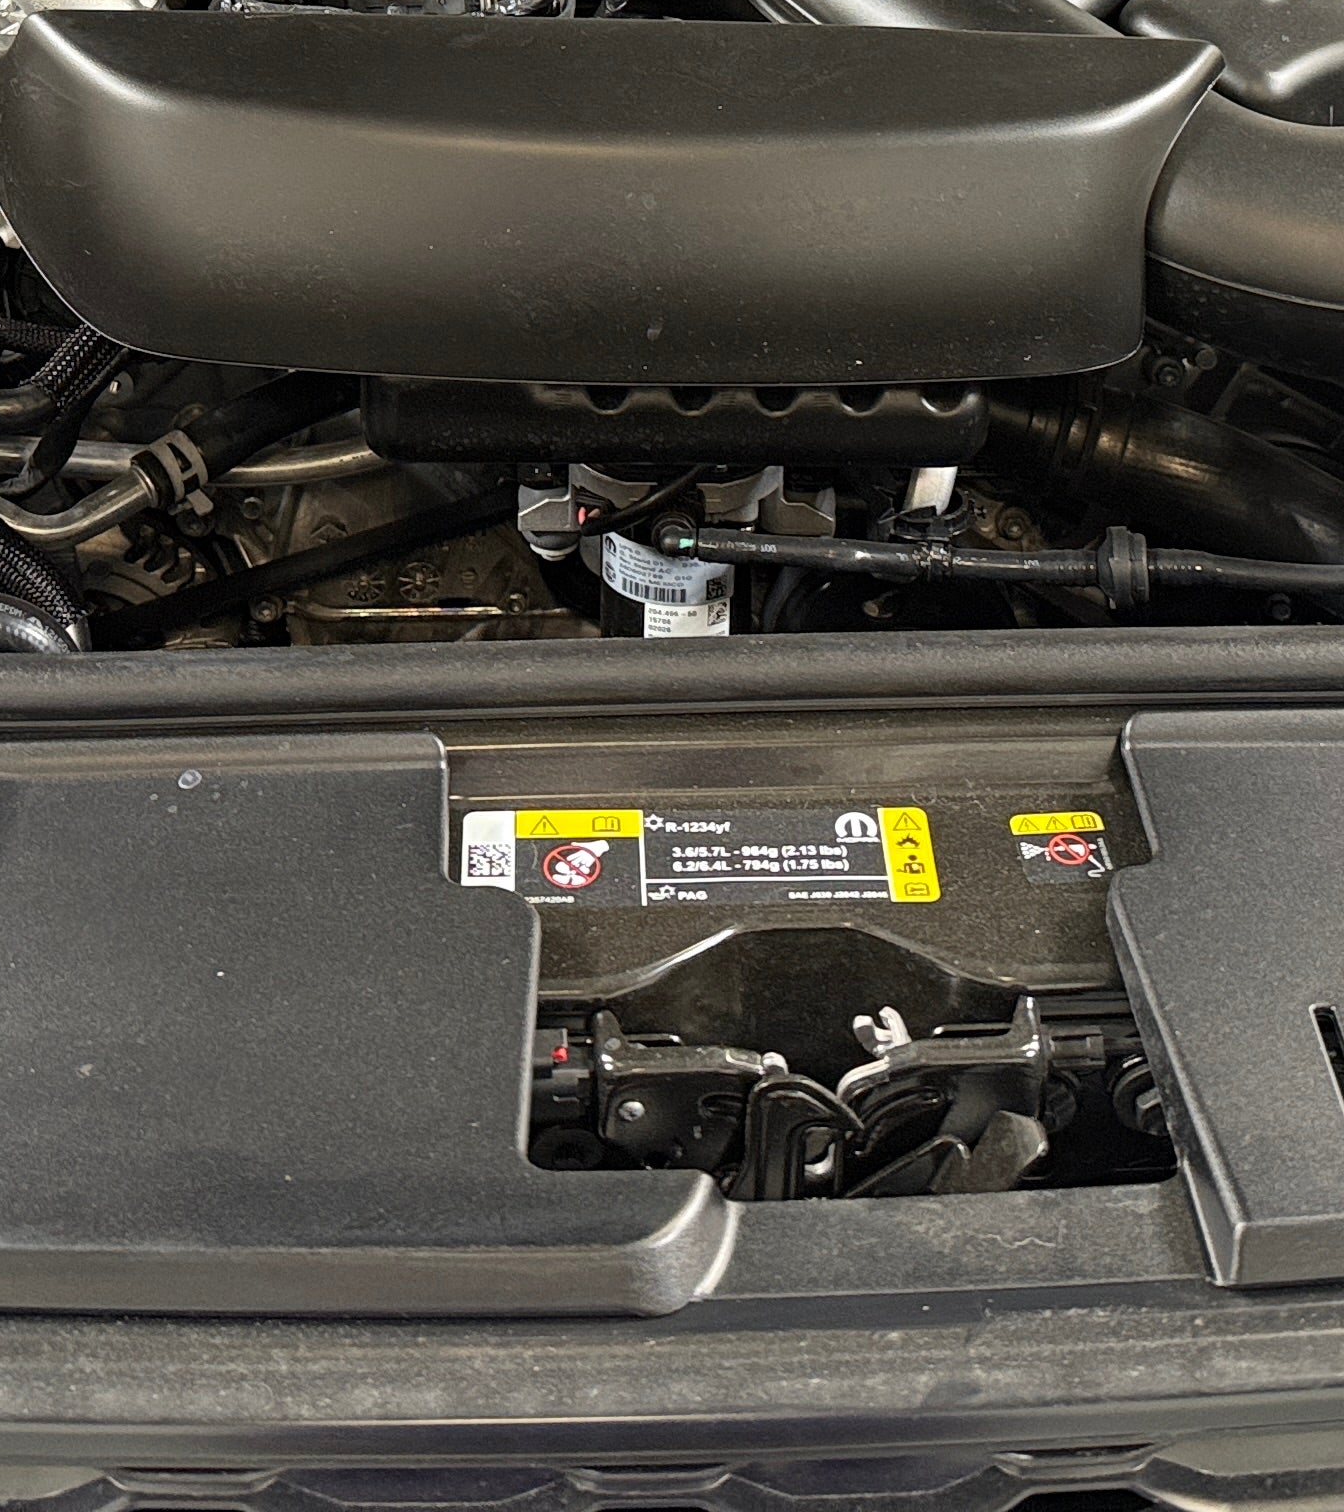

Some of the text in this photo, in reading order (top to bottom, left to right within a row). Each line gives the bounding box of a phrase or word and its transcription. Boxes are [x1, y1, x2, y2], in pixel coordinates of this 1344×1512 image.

[665, 821, 731, 835] R-1234yf
[672, 846, 732, 858] 3.6/5.7L
[781, 845, 817, 859] (2.13
[819, 845, 848, 858] lbs)
[672, 860, 733, 873] 6.2/6.4L
[782, 858, 819, 873] (1.75
[821, 859, 850, 872] lbs)
[677, 890, 708, 901] PAG
